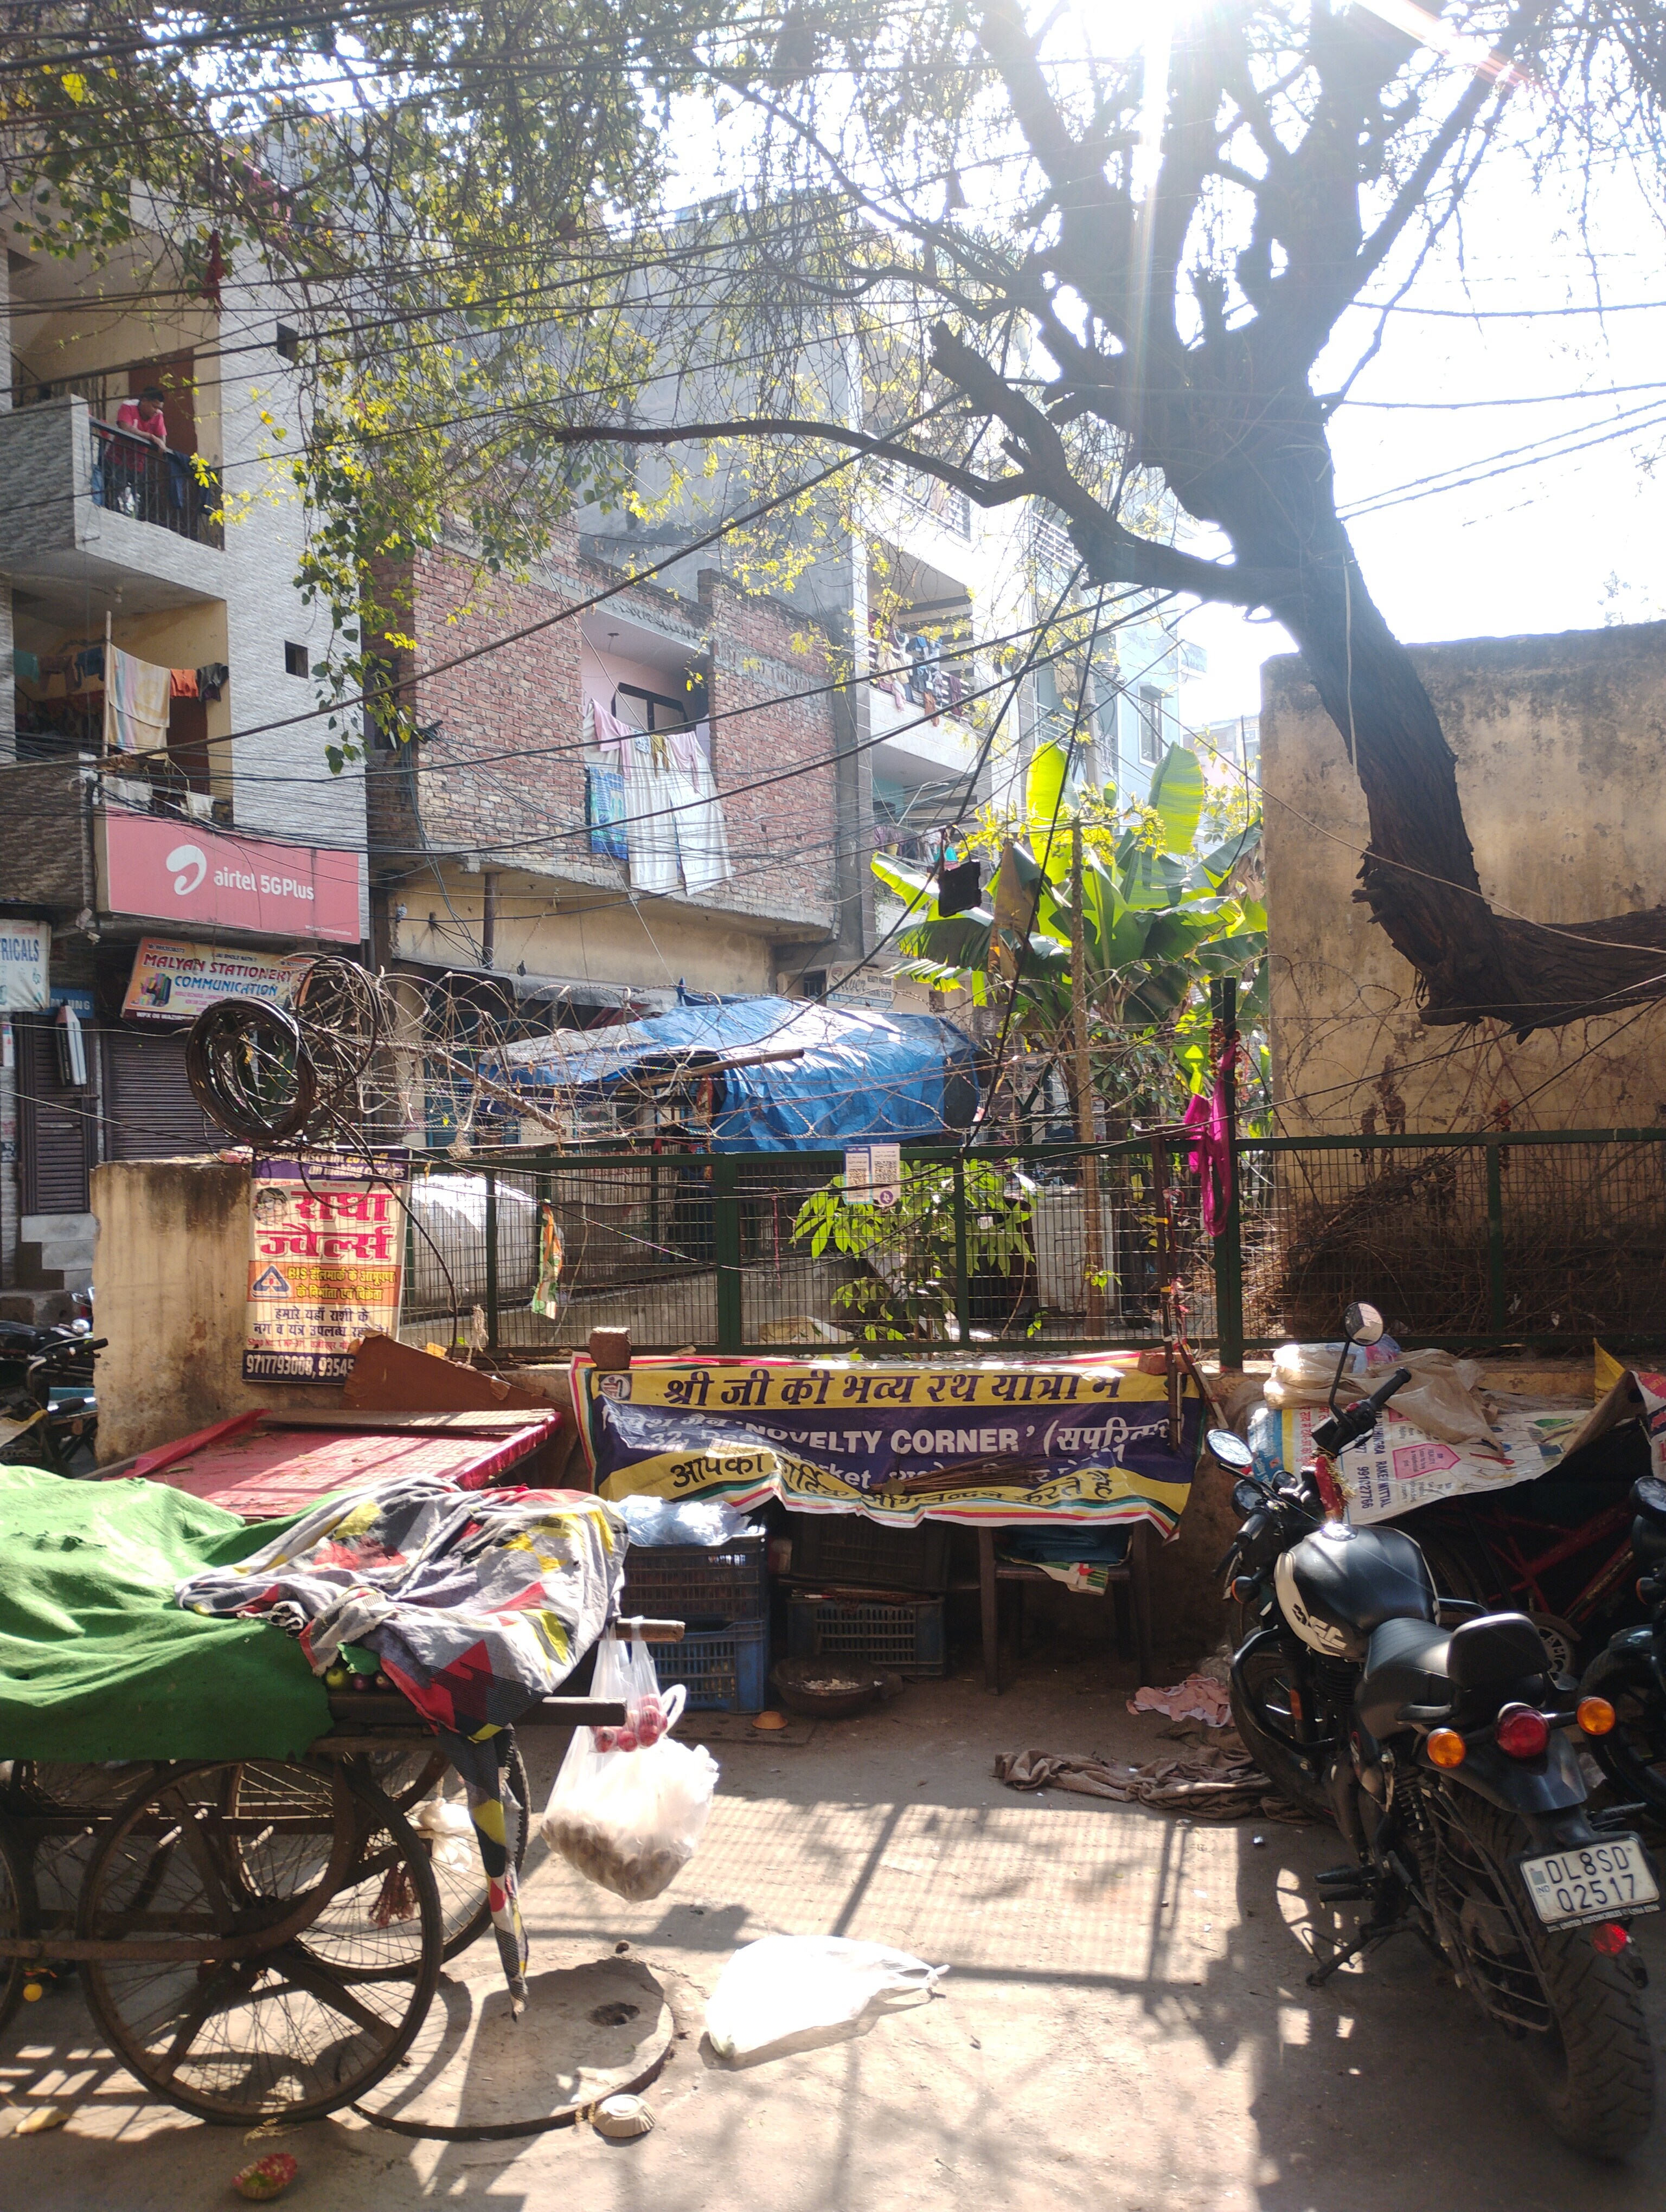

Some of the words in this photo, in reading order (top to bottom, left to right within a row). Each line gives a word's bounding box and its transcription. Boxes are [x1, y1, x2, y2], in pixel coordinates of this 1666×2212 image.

[214, 866, 257, 892] airtel
[0, 938, 40, 962] RICALS
[143, 953, 206, 972] MALYAN
[209, 962, 292, 982] STATIONERY
[175, 975, 278, 996] COMMUNICATION
[291, 1191, 393, 1222] राधा
[274, 1306, 301, 1320] हमारे
[357, 1307, 369, 1322] के
[253, 1323, 272, 1335] नग
[275, 1323, 284, 1334] व
[663, 1371, 715, 1406] श्री
[721, 1368, 775, 1406] जी
[780, 1368, 835, 1405] की
[842, 1374, 921, 1404] भव्य
[926, 1374, 985, 1403] रथ
[991, 1374, 1082, 1400] यात्रा
[670, 1453, 765, 1488] आपका
[1545, 1846, 1630, 1885] DL8SD
